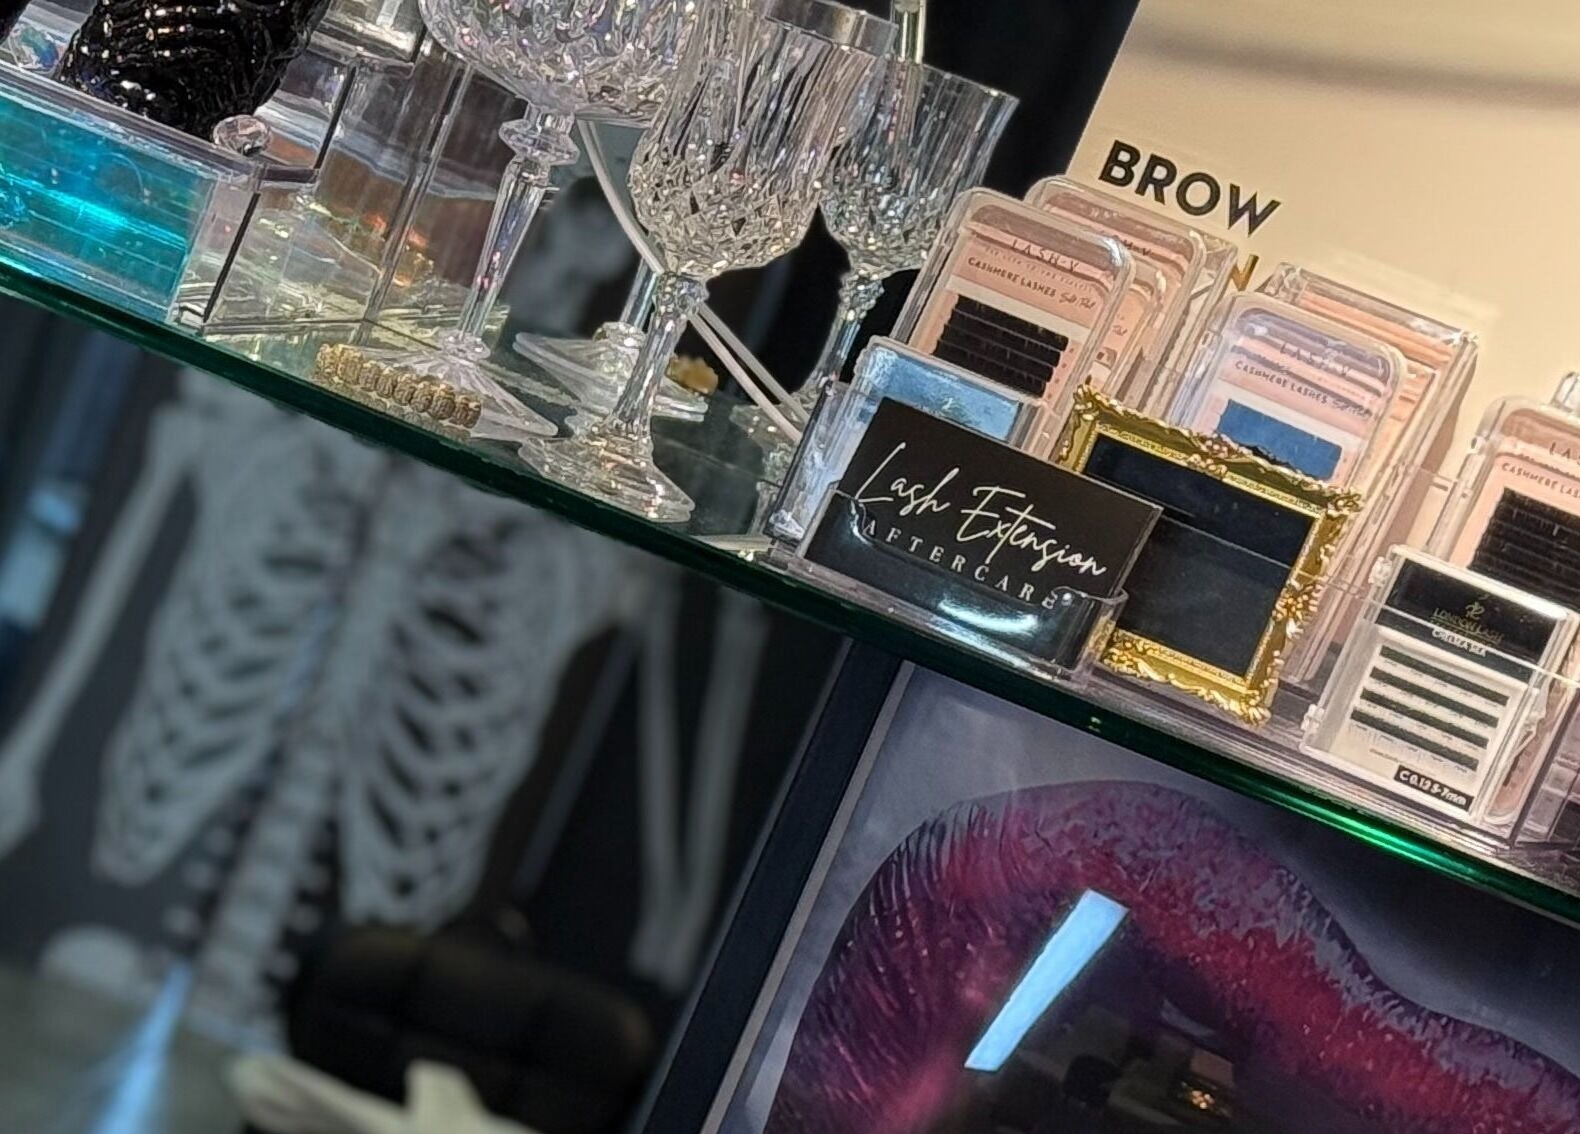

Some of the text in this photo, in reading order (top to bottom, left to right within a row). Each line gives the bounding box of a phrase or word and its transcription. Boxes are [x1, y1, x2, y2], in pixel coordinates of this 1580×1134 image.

[1099, 139, 1281, 238] BROW
[966, 255, 1020, 281] CASHMERE
[854, 441, 1108, 579] Lash Extension
[861, 517, 1058, 611] AFTERCARE
